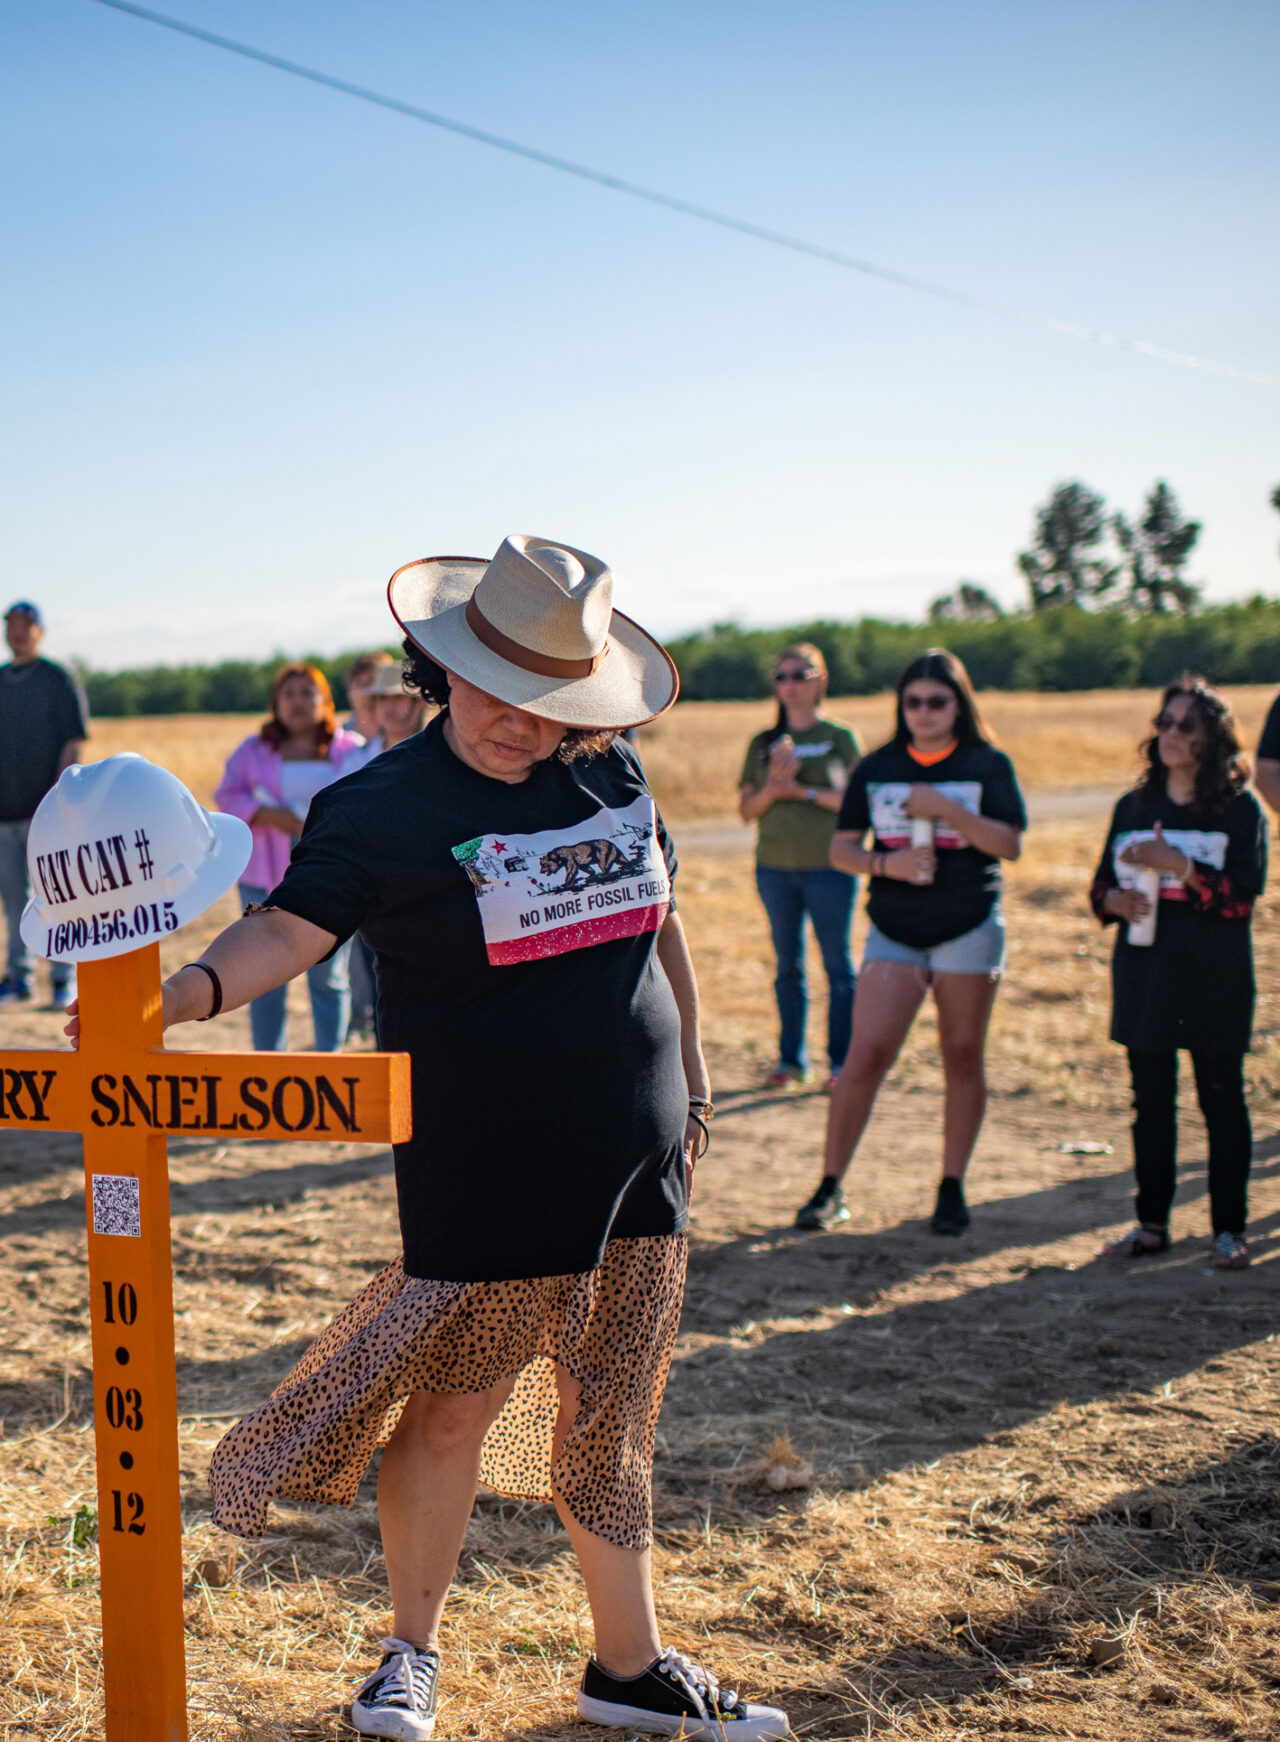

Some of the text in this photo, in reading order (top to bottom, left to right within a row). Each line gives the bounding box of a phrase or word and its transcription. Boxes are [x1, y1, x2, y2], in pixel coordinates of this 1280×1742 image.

[36, 827, 155, 906] FAT CAT #
[519, 879, 666, 929] NO MORE FOSSIL FUELS
[45, 901, 180, 959] 1600456.015
[90, 1073, 362, 1134] SNELSON
[102, 1280, 138, 1326] 10
[105, 1385, 144, 1432] 03
[111, 1489, 147, 1536] 12
